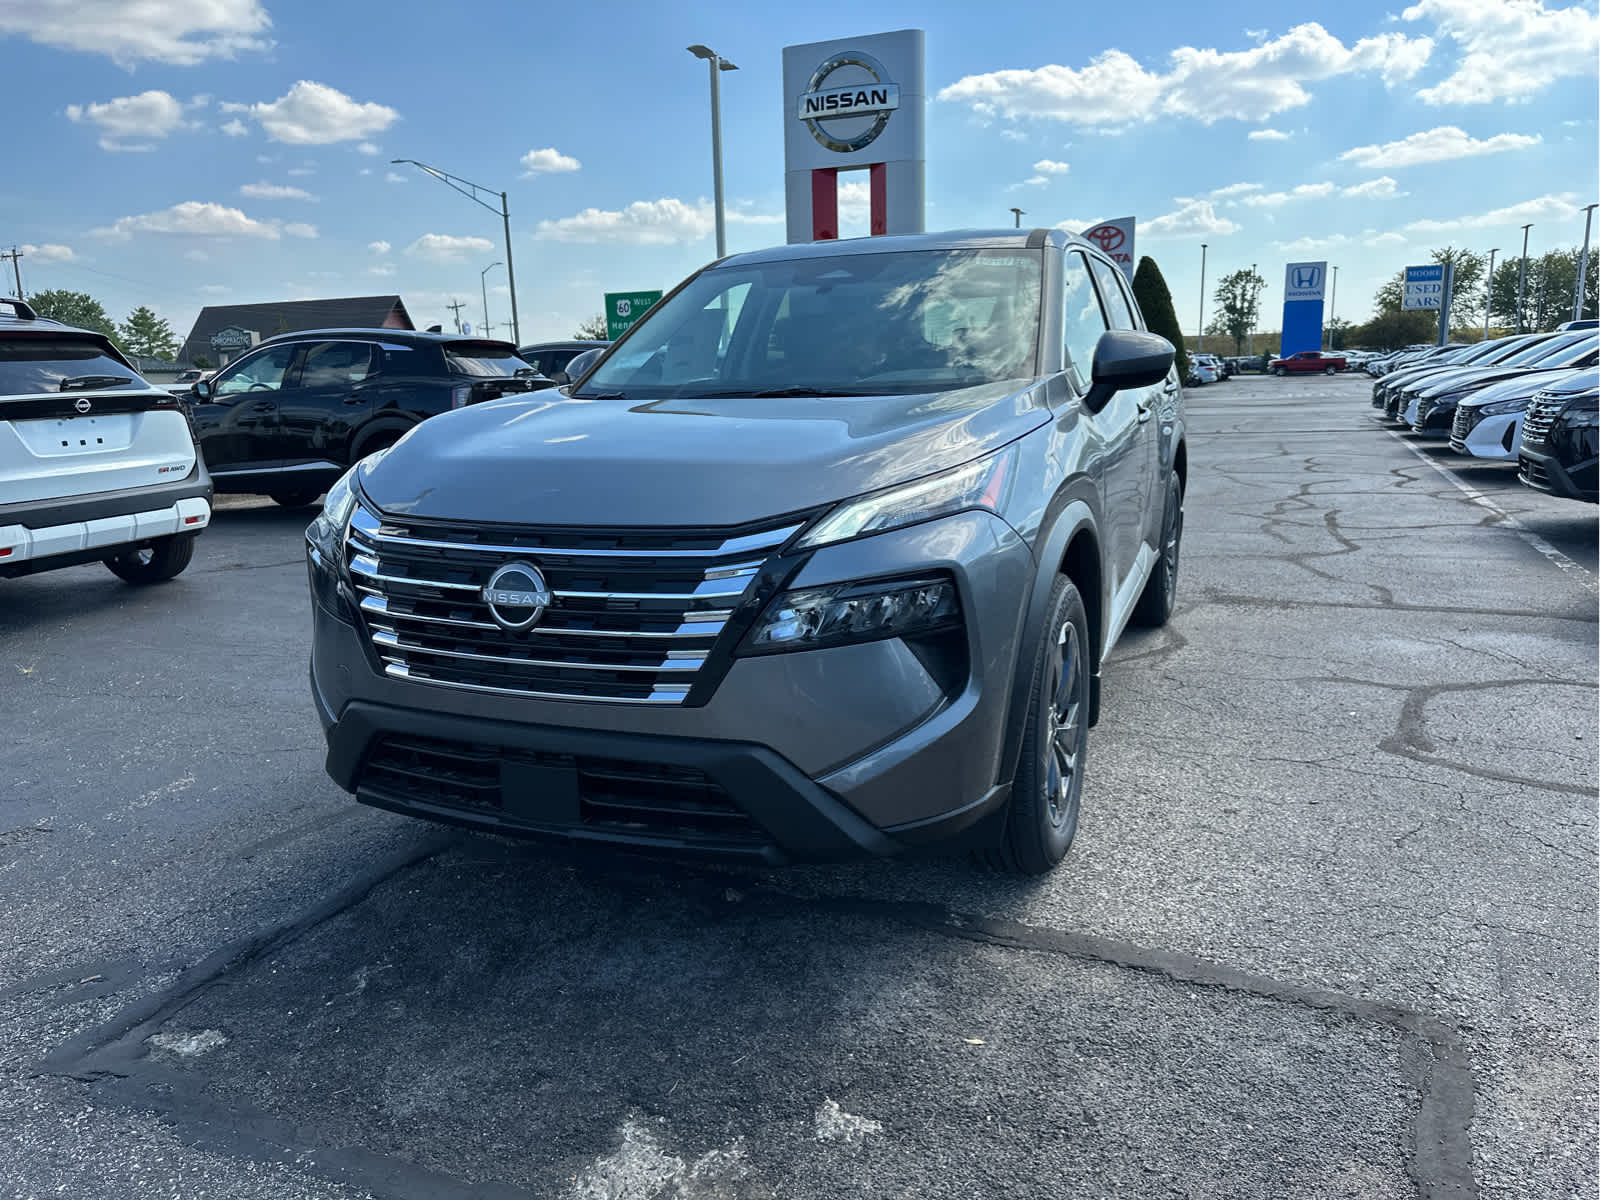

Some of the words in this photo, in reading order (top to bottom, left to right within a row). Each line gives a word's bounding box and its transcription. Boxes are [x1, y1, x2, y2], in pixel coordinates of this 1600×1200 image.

[806, 89, 888, 113] NISSAN
[1409, 269, 1441, 277] MOORE
[1406, 283, 1441, 294] USED
[618, 302, 630, 313] 60
[1404, 297, 1440, 307] CARS
[483, 591, 548, 605] NISSAN
